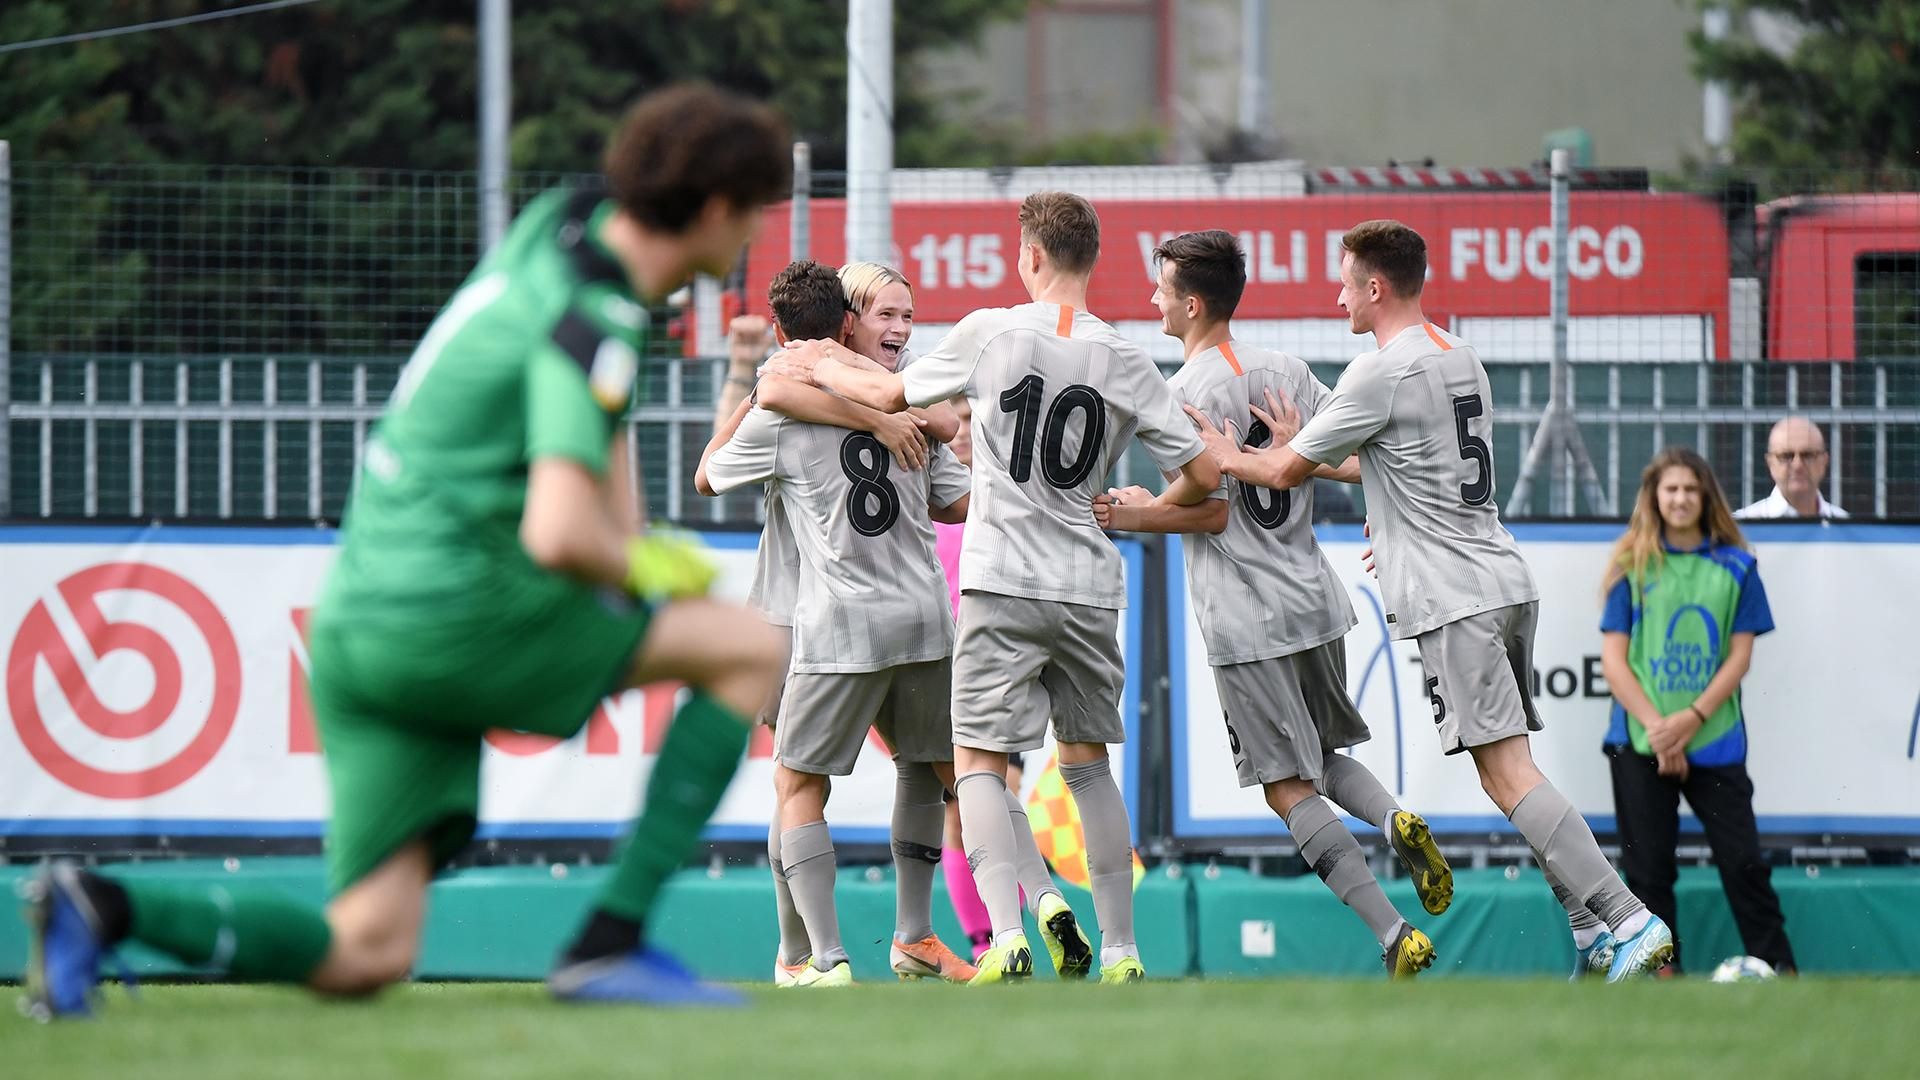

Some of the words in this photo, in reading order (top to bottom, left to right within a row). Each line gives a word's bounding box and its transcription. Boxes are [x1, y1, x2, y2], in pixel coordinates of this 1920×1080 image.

[911, 233, 1006, 289] 115
[1451, 225, 1643, 281] FUOCO
[840, 431, 900, 537] 8
[1000, 374, 1105, 489] 10
[1453, 394, 1491, 506] 5
[1426, 675, 1446, 724] 5
